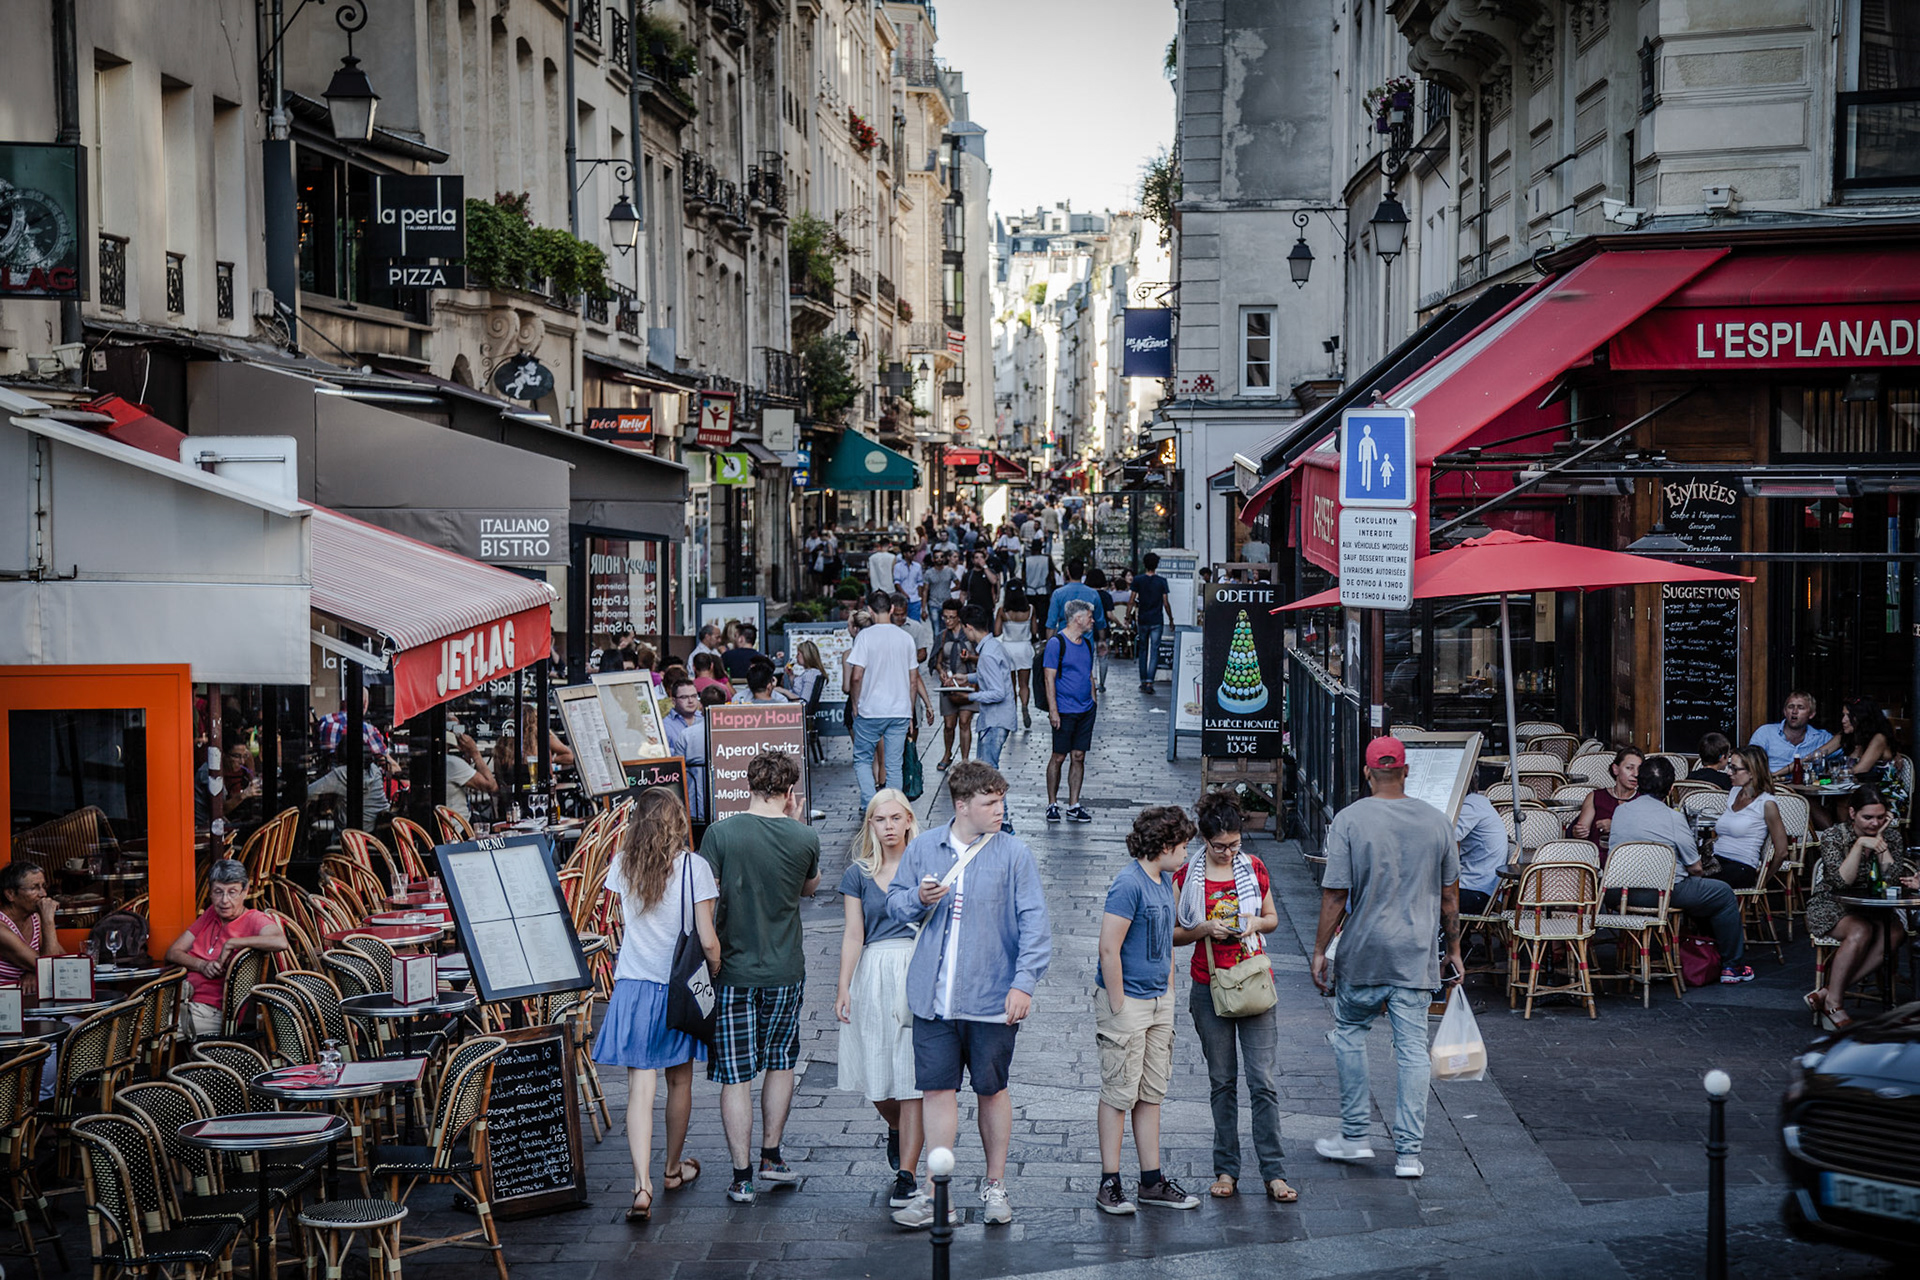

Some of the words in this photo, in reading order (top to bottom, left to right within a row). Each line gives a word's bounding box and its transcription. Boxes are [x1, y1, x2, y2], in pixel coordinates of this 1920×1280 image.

[376, 176, 396, 224] la
[401, 177, 456, 256] perla
[389, 268, 447, 285] PIZZA
[1697, 319, 1920, 358] L'ESPLANAD
[590, 418, 618, 430] Déco
[619, 416, 650, 431] Relief
[698, 434, 731, 444] NATURALIA
[1663, 480, 1738, 508] ENTRÉES
[480, 518, 550, 533] ITALIANO
[1354, 516, 1398, 525] CIRCULATION
[1358, 530, 1393, 538] INTERDITE
[480, 539, 550, 557] BISTRO
[1354, 540, 1380, 550] VÉHICULES
[1382, 542, 1409, 551] MOTORISÉS
[1358, 554, 1384, 562] DESSERTE
[1386, 556, 1407, 564] INTERNE
[1344, 566, 1374, 574] LIVRAISONS
[1376, 568, 1406, 576] AUTORISÉES
[1346, 578, 1354, 586] DE
[1378, 579, 1382, 587] À
[1384, 580, 1404, 588] 13H00
[1216, 589, 1274, 603] ODETTE
[1362, 592, 1380, 600] 15H00
[1382, 592, 1386, 600] À
[1388, 594, 1407, 602] 16H00
[1662, 584, 1740, 600] SUGGESTIONS
[436, 620, 515, 697] JET-LAG
[712, 711, 762, 728] Happy
[765, 710, 802, 724] Hour
[1205, 718, 1217, 728] LA
[716, 742, 759, 760] Aperol
[716, 769, 748, 781] Negro
[476, 838, 506, 852] MENU
